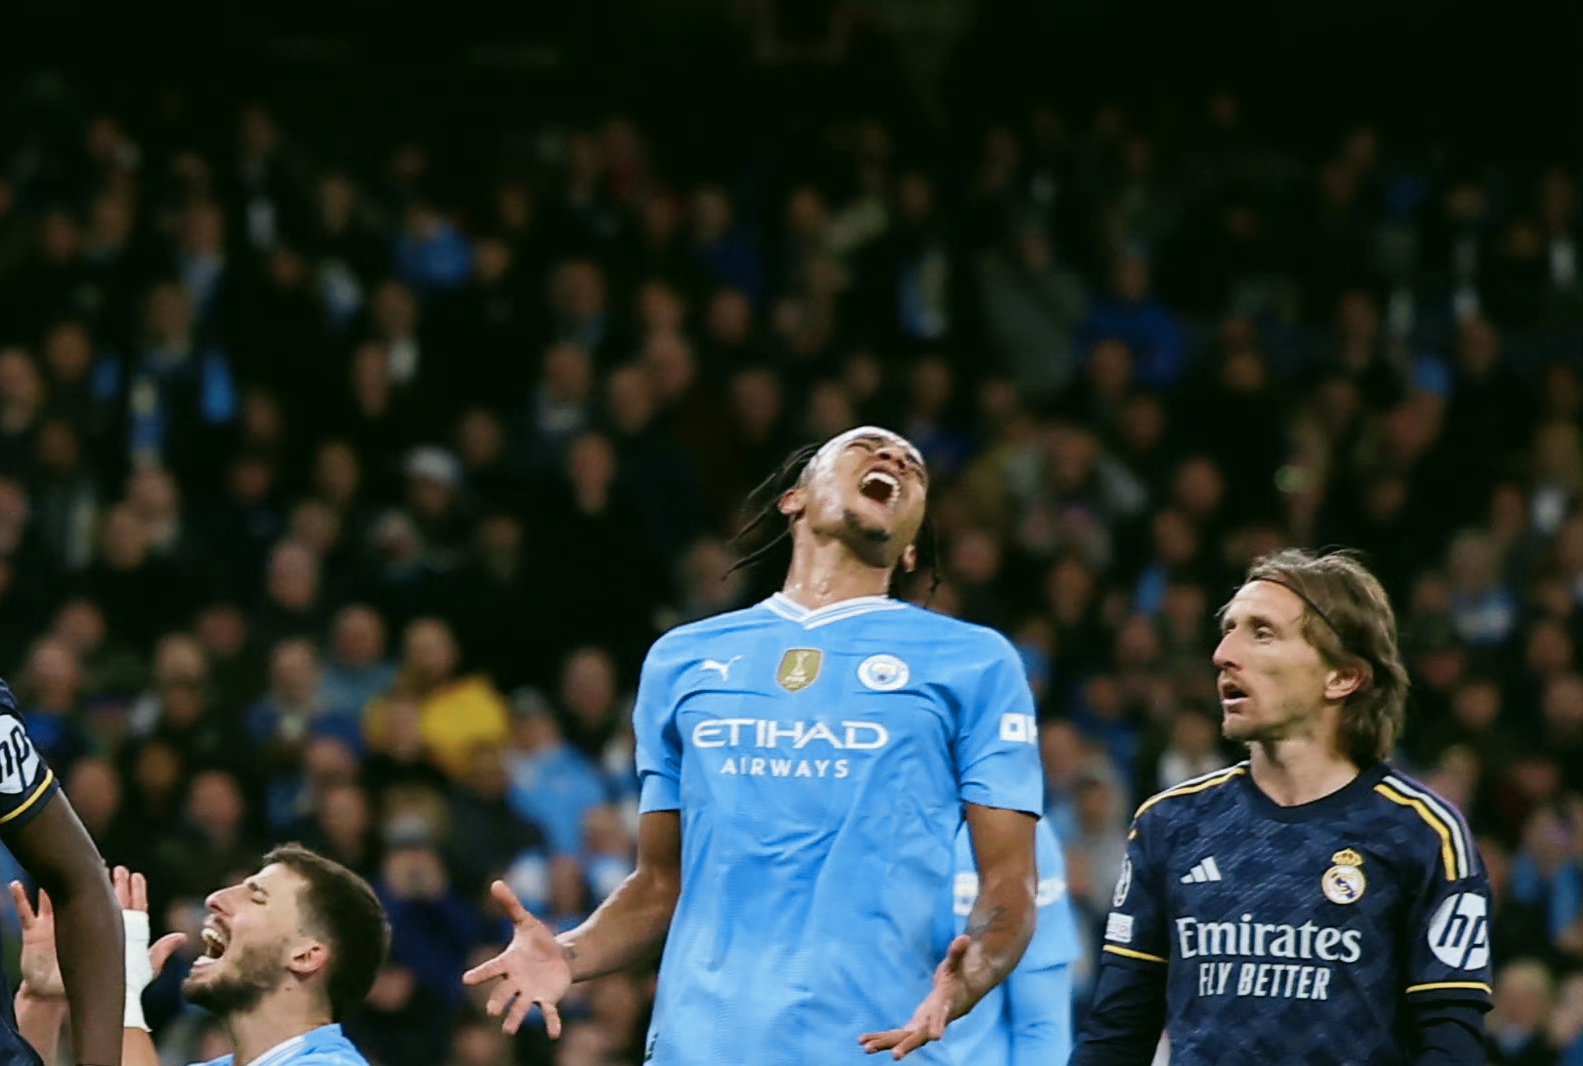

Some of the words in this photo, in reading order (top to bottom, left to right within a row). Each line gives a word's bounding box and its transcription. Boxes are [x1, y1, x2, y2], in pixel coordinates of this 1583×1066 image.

[691, 717, 890, 750] ETIHAD
[719, 757, 851, 780] AIRWAYS
[1174, 912, 1363, 964] Emirates
[1198, 962, 1229, 998] FLY
[1236, 962, 1333, 1001] BETTER
